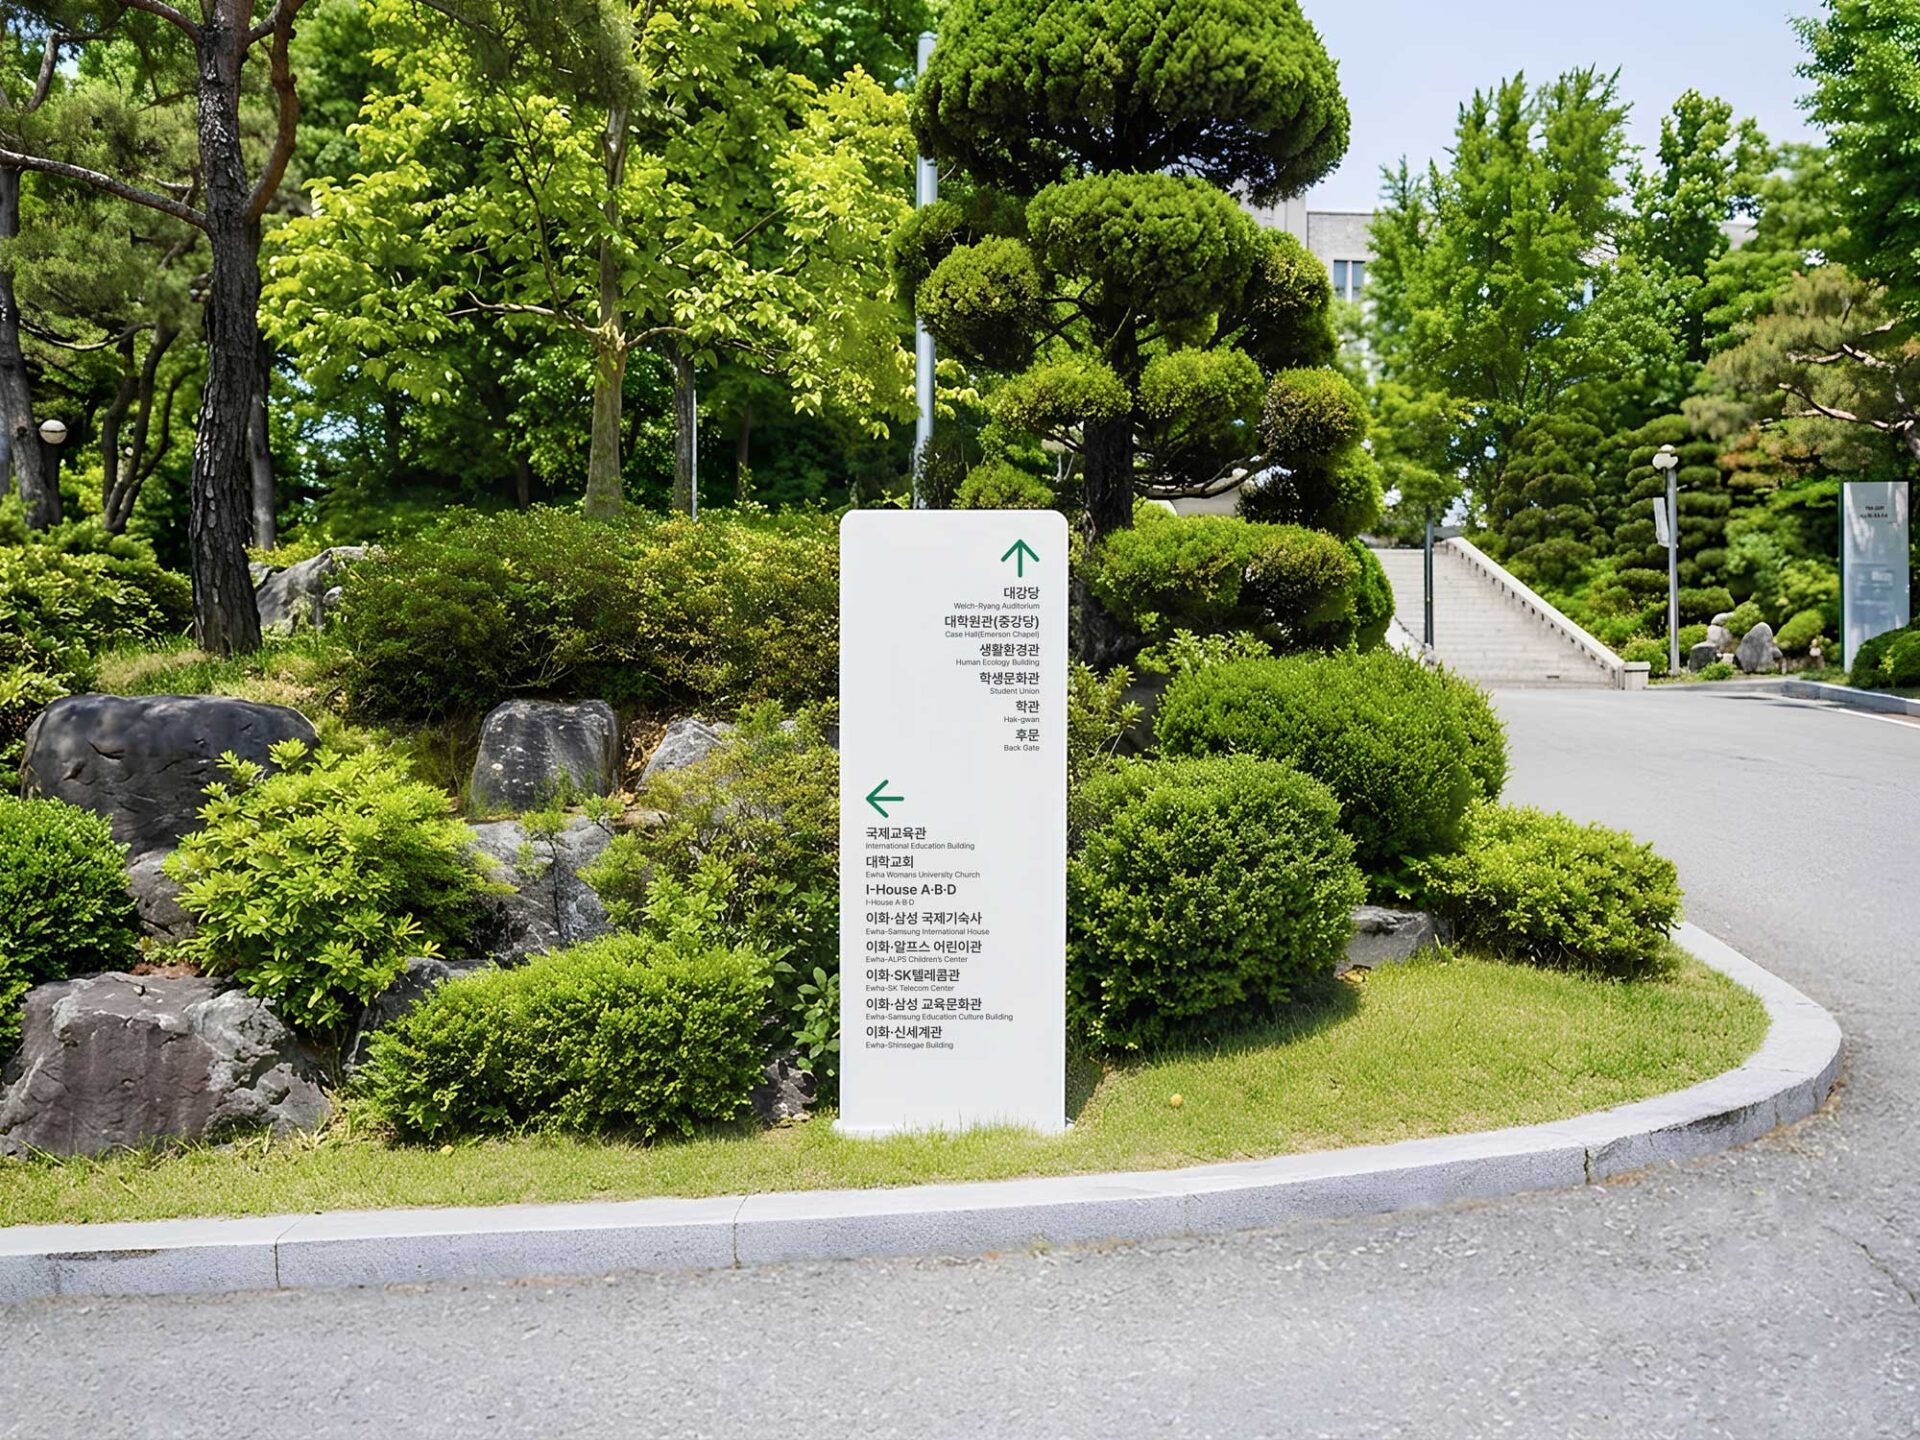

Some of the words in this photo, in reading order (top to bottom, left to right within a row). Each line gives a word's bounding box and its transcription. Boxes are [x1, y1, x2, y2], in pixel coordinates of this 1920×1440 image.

[1004, 586, 1040, 600] 대강당
[945, 615, 1039, 630] 대학원관(중강당)
[965, 631, 1010, 639] Hall(Emerson
[1012, 631, 1039, 639] Chapel)
[979, 643, 1040, 657] 생활환경관
[983, 659, 1010, 667] Ecology
[1012, 659, 1040, 667] Building
[979, 671, 1040, 685] 학생문화관
[1015, 700, 1040, 713] 학관
[1004, 716, 1040, 724] Hak-gwan
[1016, 728, 1040, 742] 후문
[866, 826, 927, 840] 국제교육관
[947, 843, 975, 851] Building
[866, 855, 913, 869] 대학교회
[918, 871, 953, 879] University
[866, 884, 917, 895] I-House
[921, 884, 956, 895] A·B·D
[866, 911, 917, 925] 이화·삼성
[921, 912, 982, 925] 국제기숙사
[865, 928, 920, 936] Ewha-Samsung
[866, 940, 930, 954] 이화·알프스
[934, 940, 982, 954] 어린이관
[866, 968, 960, 982] 이화·SK텔레콤관
[866, 997, 918, 1011] 이화·삼성
[921, 997, 982, 1011] 교육문화관
[866, 1013, 920, 1022] Ewha-Samsung
[986, 1013, 1013, 1022] Building
[866, 1025, 943, 1039] 이화·신세계관
[866, 1041, 924, 1050] Ewha-Shinsegae
[926, 1042, 954, 1050] Building
